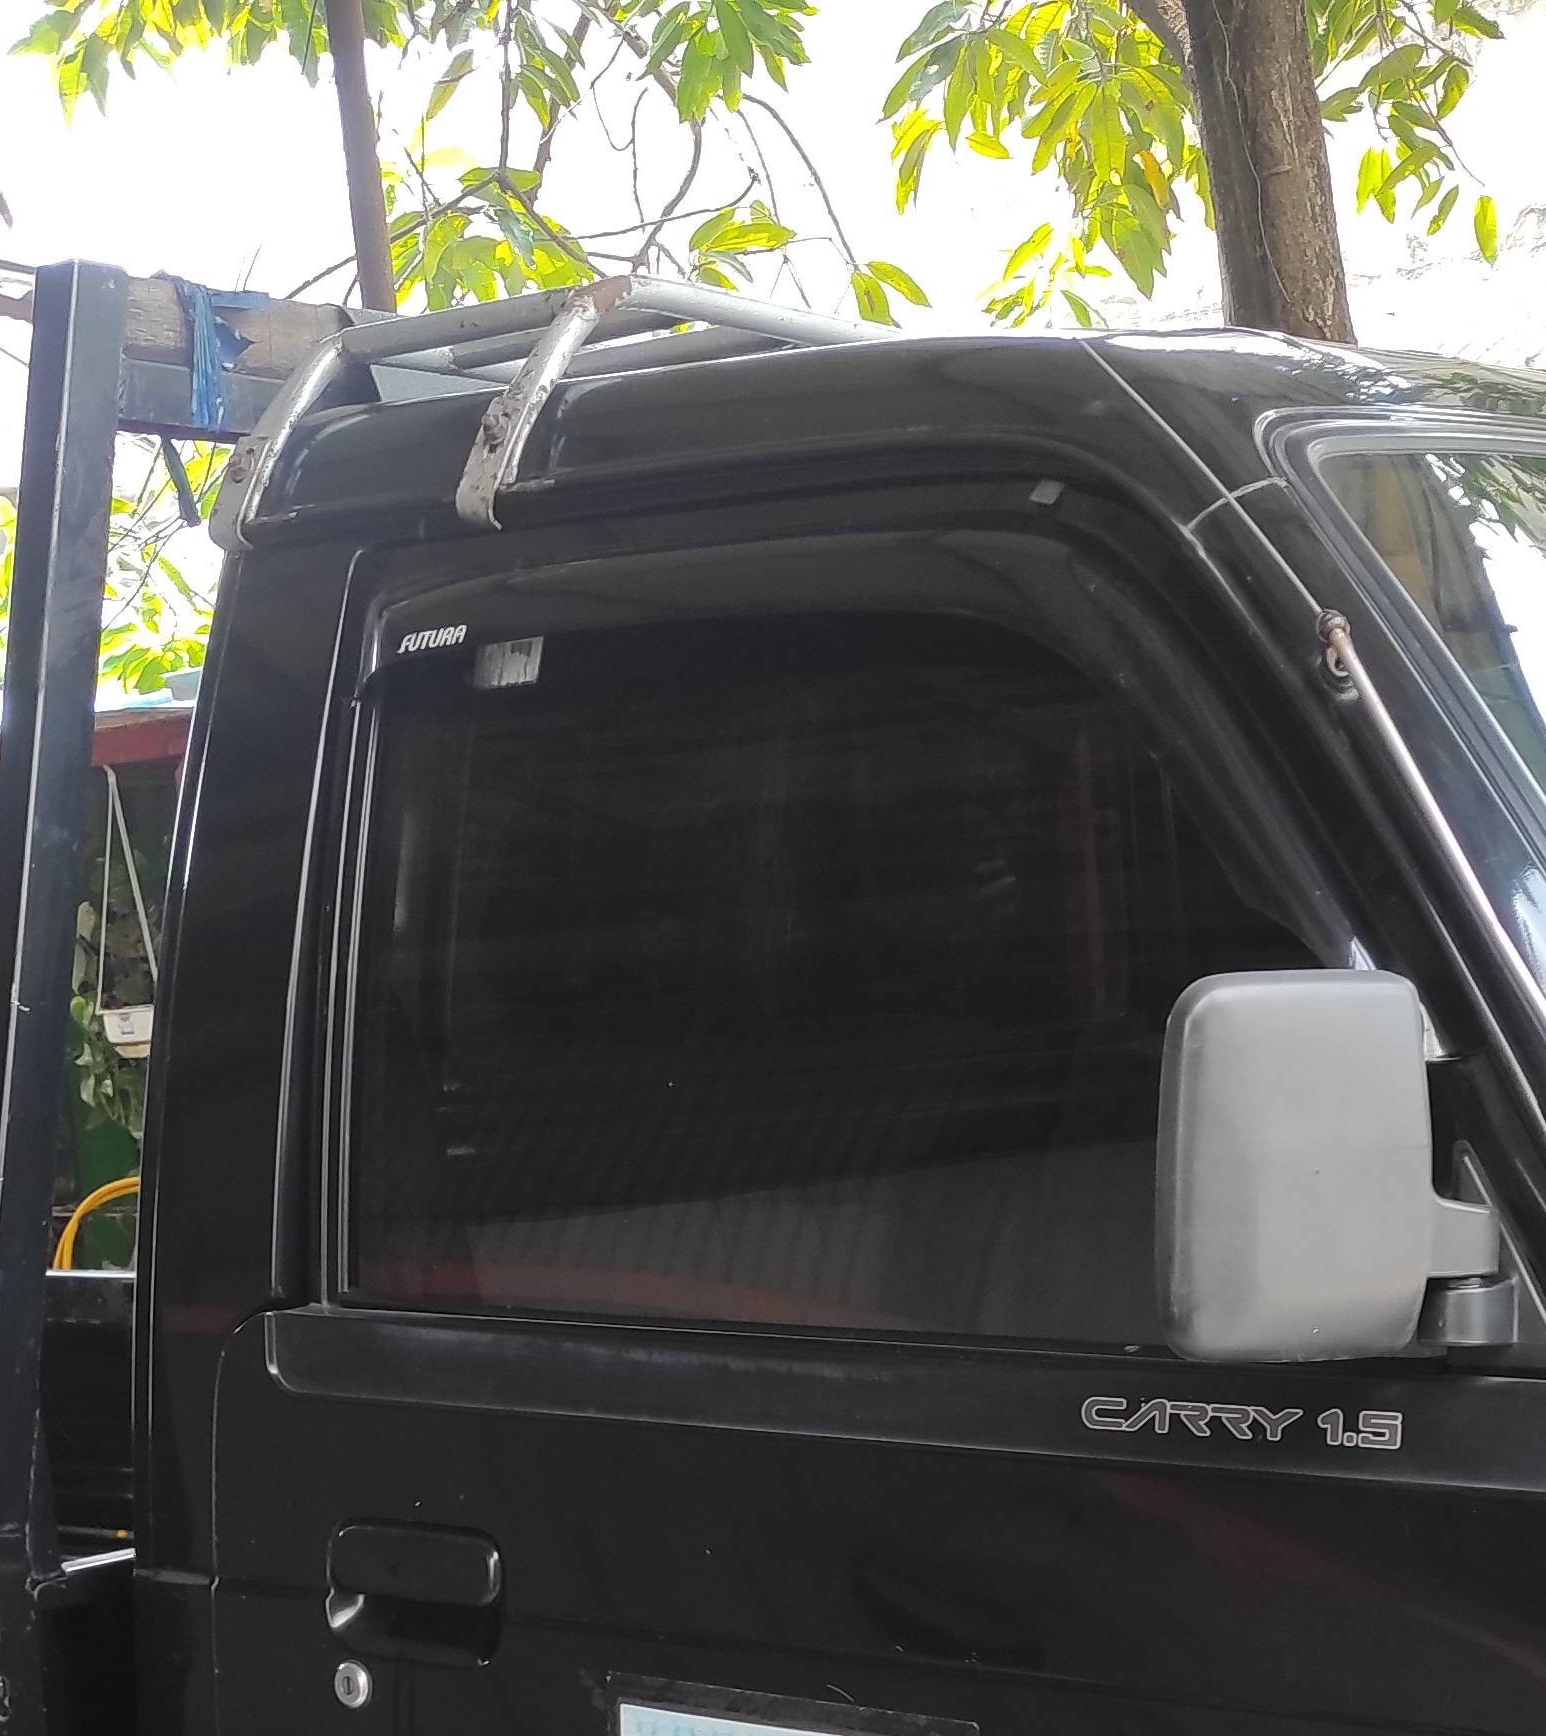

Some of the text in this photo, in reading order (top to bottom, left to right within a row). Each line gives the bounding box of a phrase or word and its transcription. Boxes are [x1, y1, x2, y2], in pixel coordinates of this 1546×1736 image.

[396, 624, 468, 655] FUTURA
[1080, 1396, 1403, 1450] CARRY 1.5
